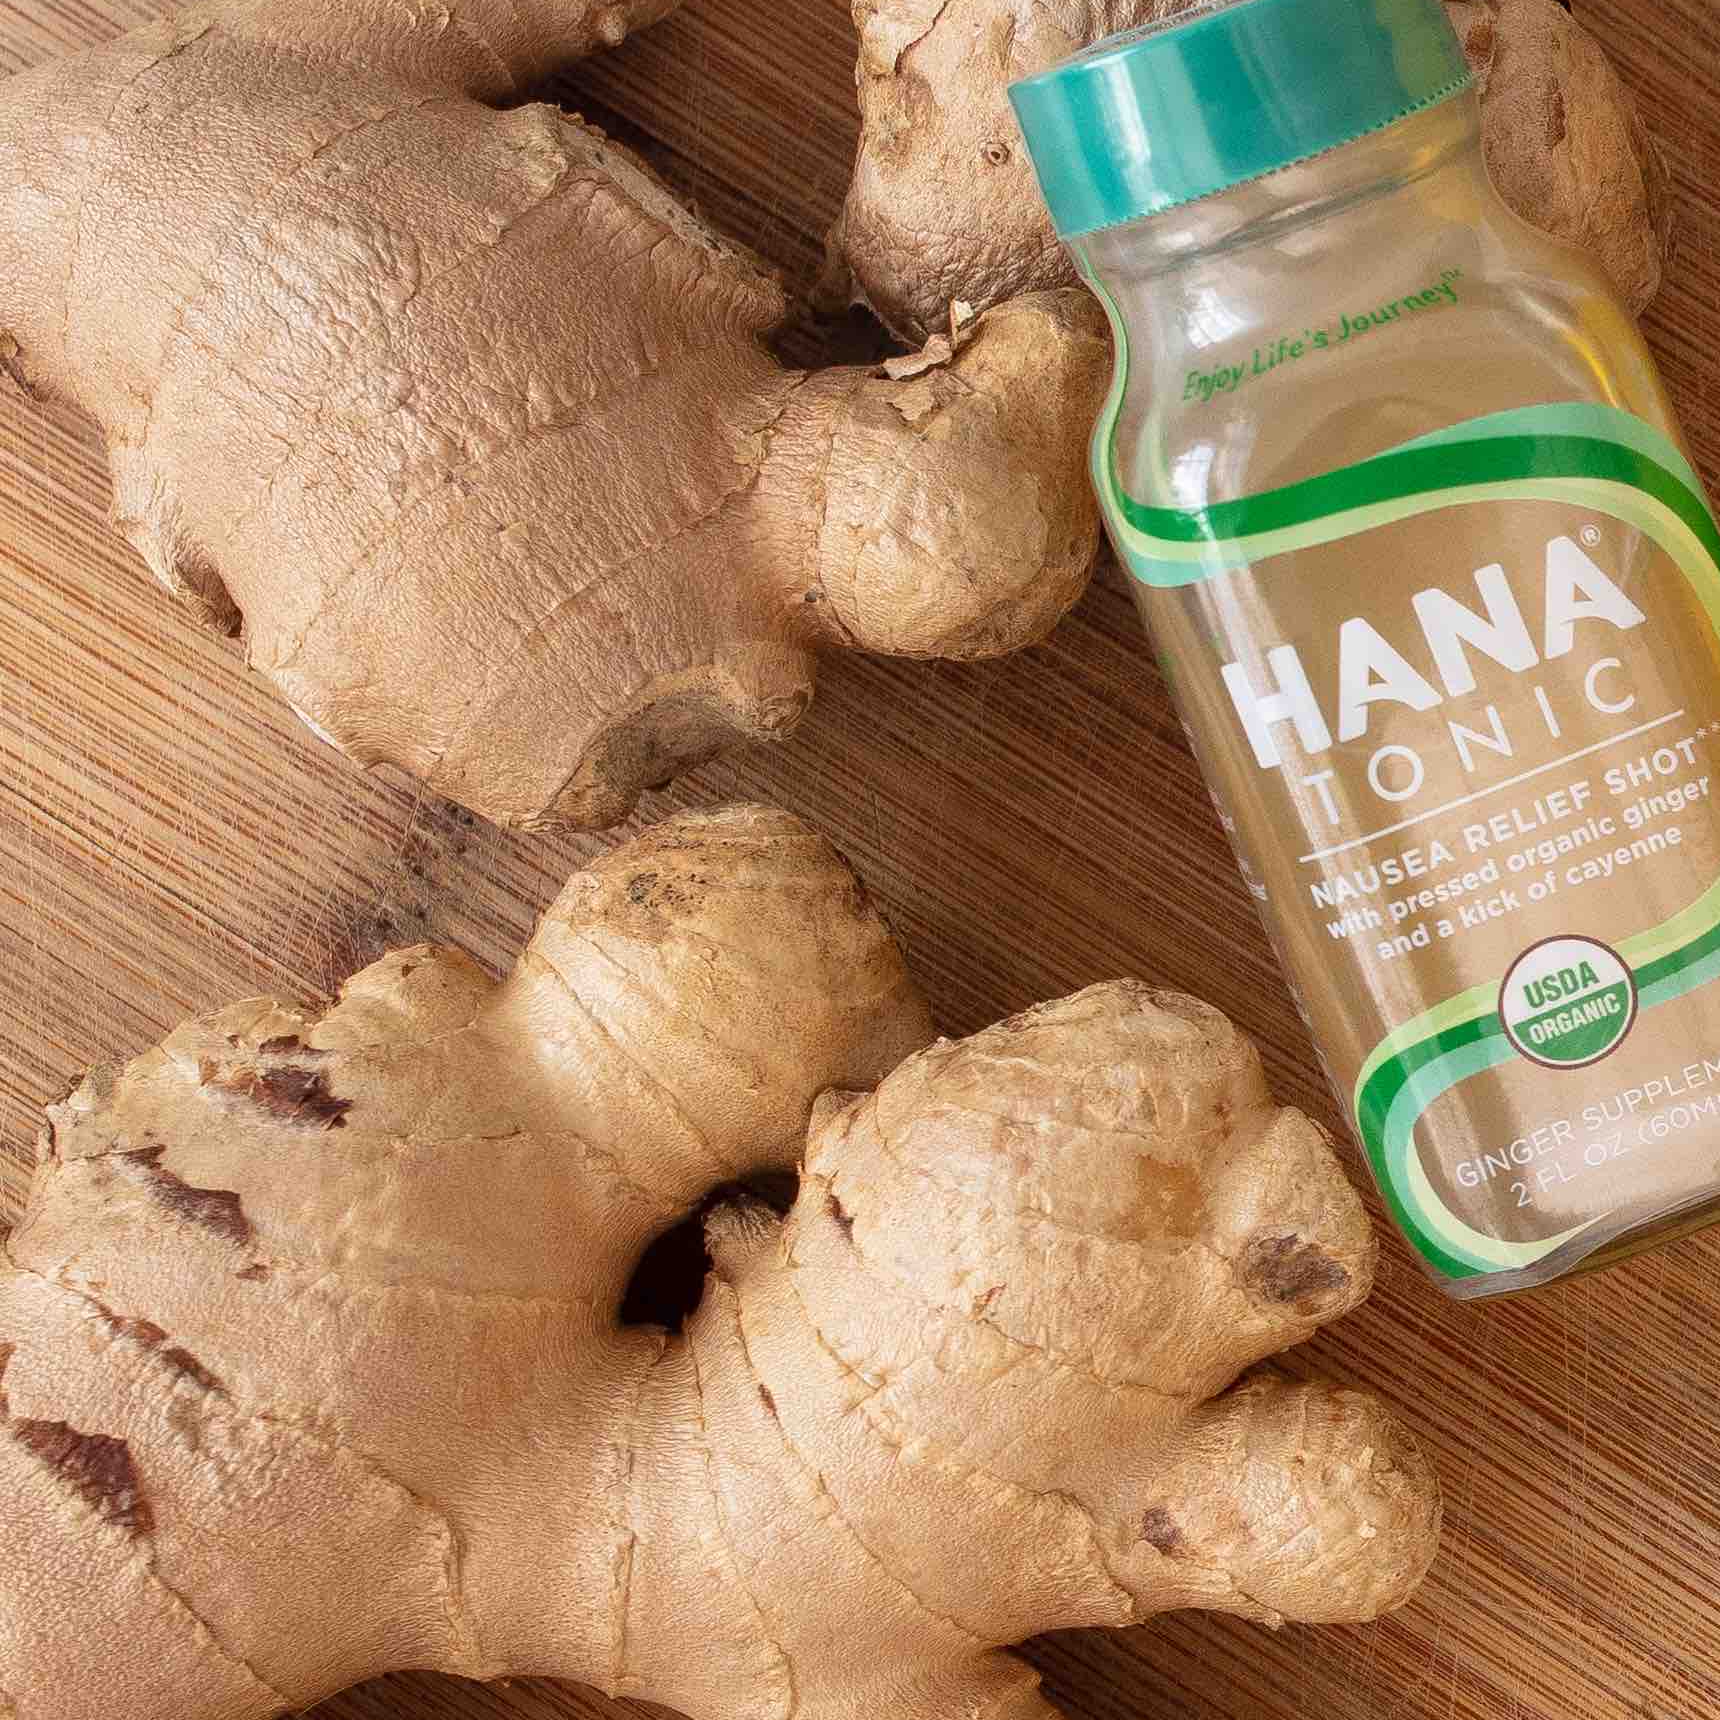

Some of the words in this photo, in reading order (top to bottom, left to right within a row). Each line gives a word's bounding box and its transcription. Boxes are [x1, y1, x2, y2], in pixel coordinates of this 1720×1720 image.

[1183, 359, 1245, 401] Enjoy
[1251, 328, 1329, 377] Life's
[1302, 657, 1635, 826] TONIC
[1310, 839, 1455, 911] NAUSEA
[1463, 781, 1594, 855] RELIEF
[1326, 899, 1380, 940] with
[1390, 861, 1499, 923] pressed
[1506, 813, 1616, 874] organic
[1623, 775, 1710, 829] ginger
[1376, 922, 1431, 961] and
[1437, 917, 1455, 939] a
[1457, 885, 1520, 930] kick
[1527, 869, 1559, 900] of
[1566, 826, 1682, 886] cayenne
[1523, 960, 1601, 1010] USDA
[1527, 991, 1622, 1046] ORGANIC
[1456, 1118, 1575, 1188] GINGER
[1510, 1182, 1532, 1208] 2
[1539, 1165, 1577, 1199] FL
[1583, 1134, 1633, 1169] OZ
